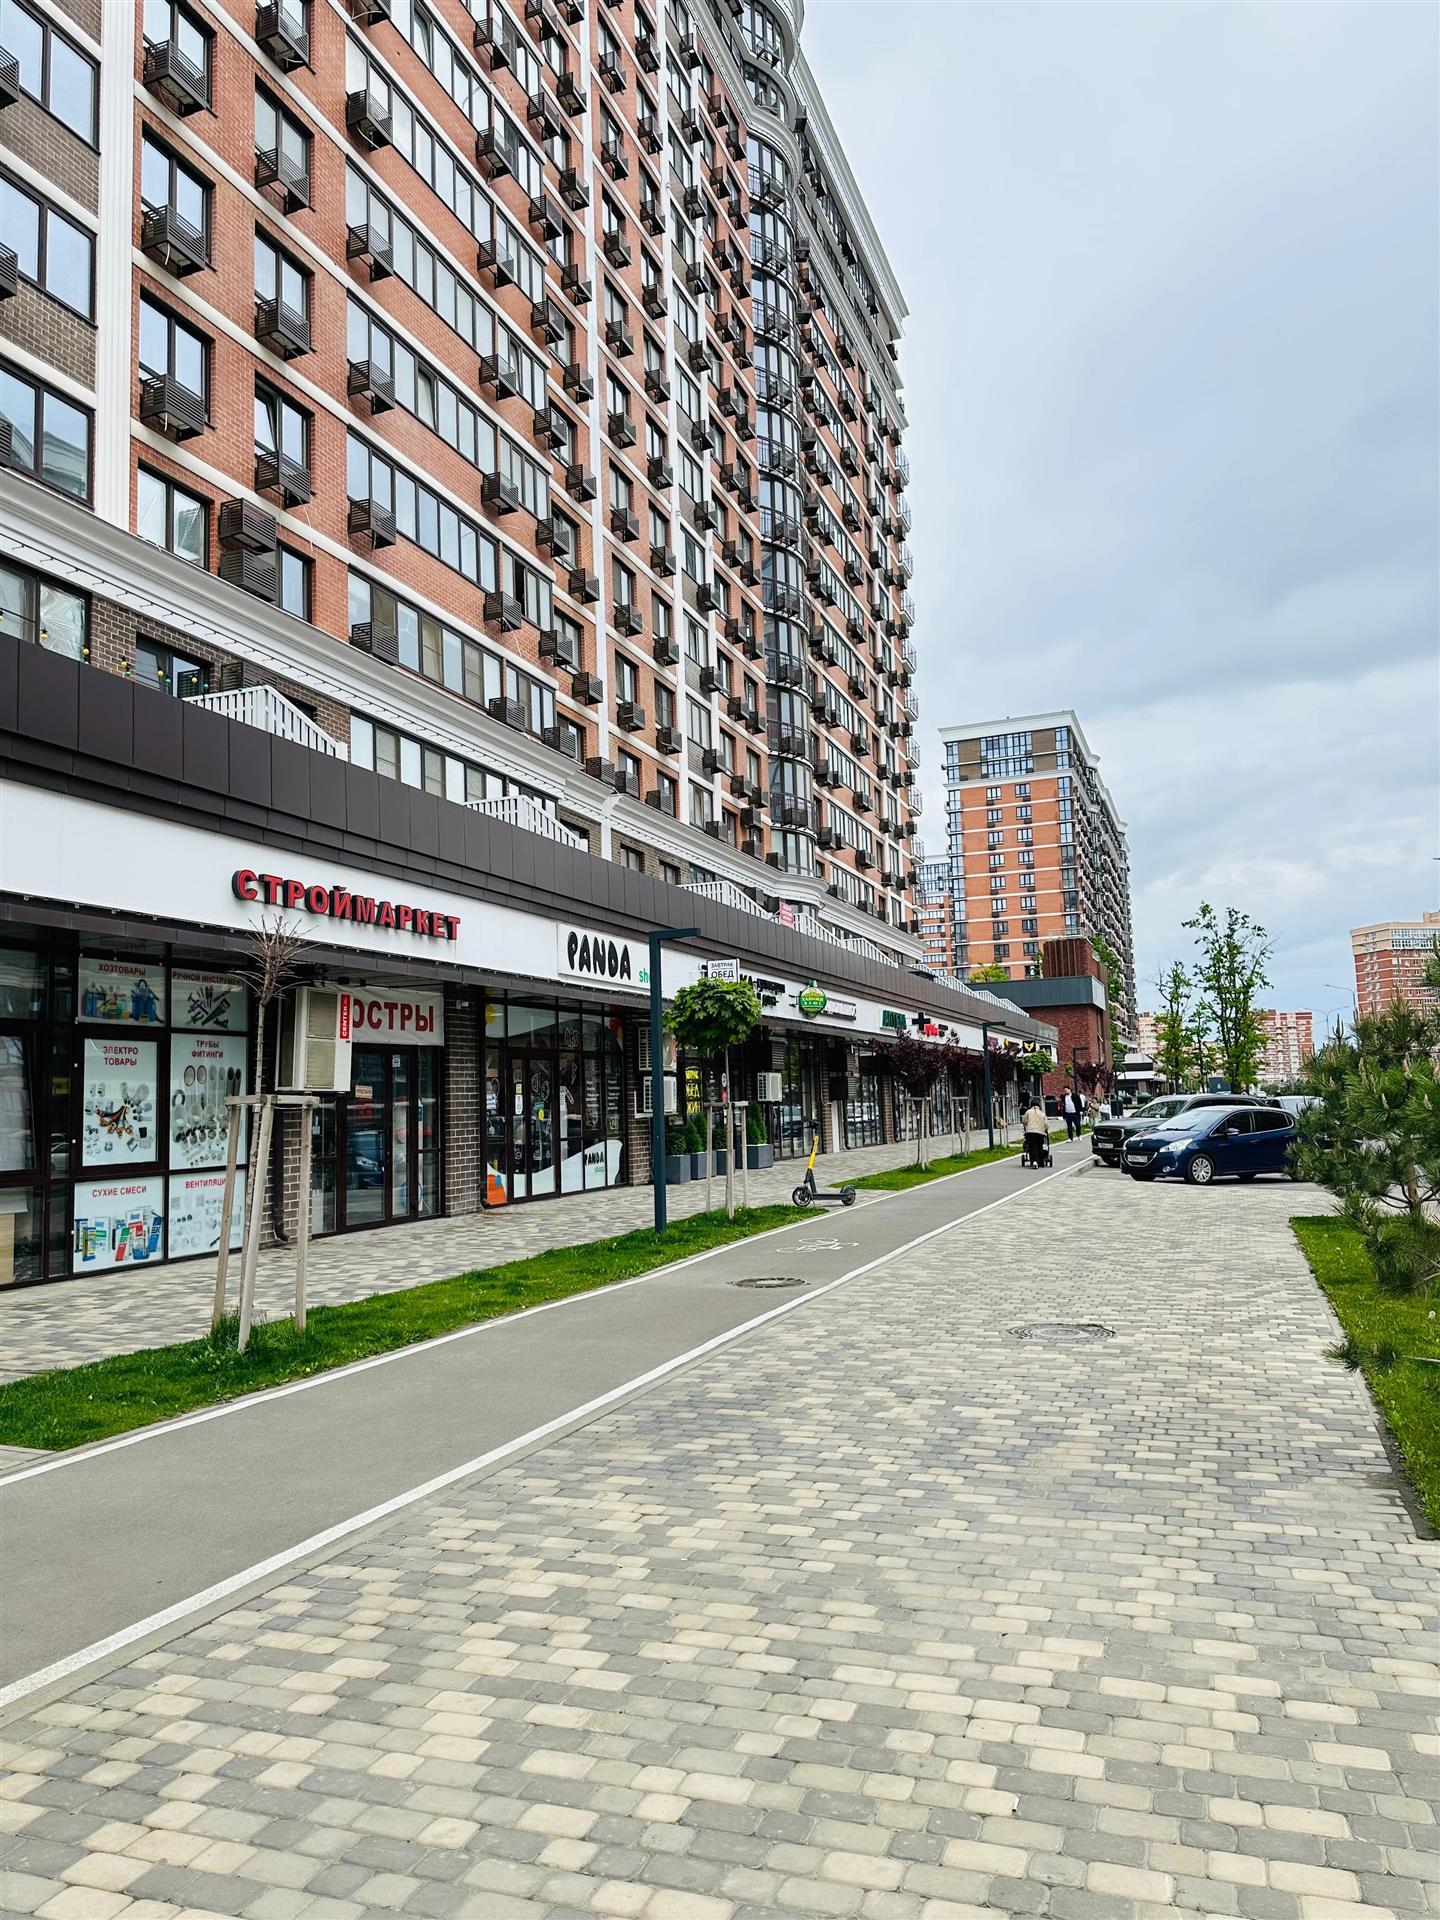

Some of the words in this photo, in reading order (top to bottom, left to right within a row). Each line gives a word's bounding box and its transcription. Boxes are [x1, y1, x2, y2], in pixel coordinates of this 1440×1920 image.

[232, 869, 461, 940] СТРОЙМАРКЕТ
[567, 931, 631, 981] PANDA
[98, 963, 146, 976] ХОЗТОВАРЫ
[638, 967, 650, 984] sh
[711, 969, 735, 979] ОБЕД
[172, 971, 201, 983] РУЧНОЙ
[202, 974, 245, 986] ИНСТРУМЕНТ
[196, 1040, 219, 1048] ТРУБЫ
[103, 1046, 139, 1055] ЭЛЕКТРО
[191, 1050, 224, 1059] ФИТИНГИ
[104, 1057, 137, 1066] ТОВАРЫ
[185, 1178, 226, 1189] ВЕНТИЛЯЦИ
[92, 1187, 118, 1198] СУХИЕ
[120, 1185, 147, 1195] СМЕСИ
